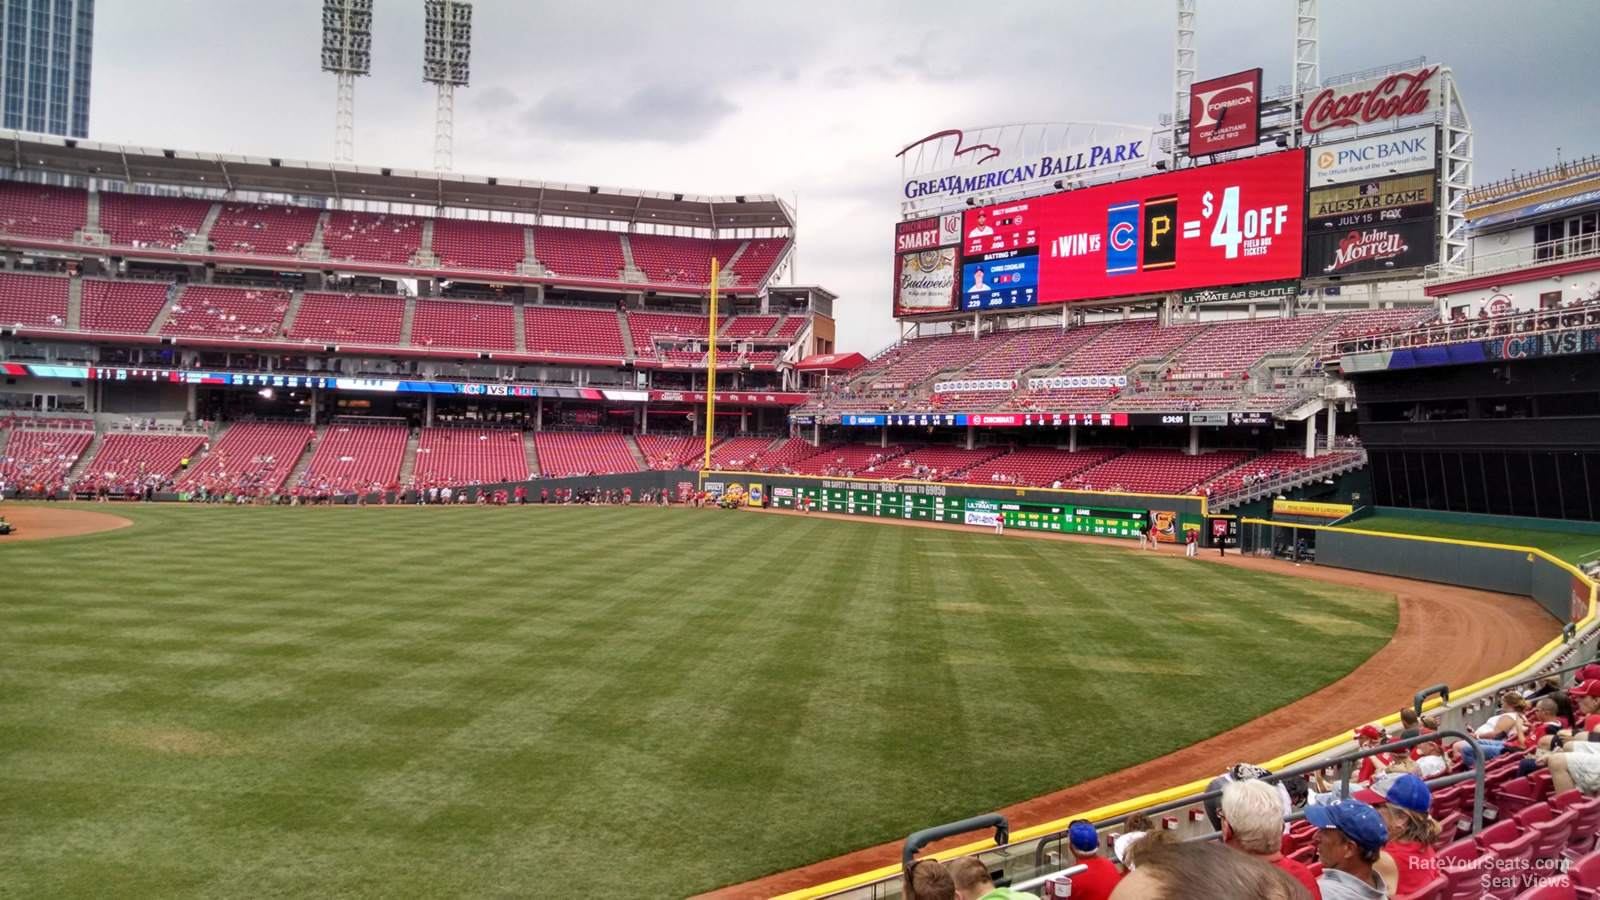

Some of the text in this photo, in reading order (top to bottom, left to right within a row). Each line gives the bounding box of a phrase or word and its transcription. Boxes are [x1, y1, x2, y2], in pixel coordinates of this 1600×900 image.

[1208, 97, 1251, 112] FORMICA
[1303, 66, 1439, 133] Coca-Cola
[1200, 124, 1246, 138] CINCNATIANS
[1337, 136, 1426, 165] PNC BANK
[904, 140, 1143, 198] GREAT AMERICAN BALL PARK
[1382, 158, 1410, 167] Cincinnati
[1411, 154, 1427, 162] Reds
[1385, 189, 1425, 206] GAME
[1244, 205, 1288, 239] OFF
[1338, 208, 1402, 226] JULY 15 FOX
[899, 218, 938, 234] CINCINNATI
[899, 230, 938, 250] SMART
[1052, 232, 1101, 257] A WIN VS
[1244, 237, 1272, 248] FIELD BOX
[1357, 229, 1388, 246] John
[969, 244, 982, 252] .272
[984, 251, 1009, 260] BATTING
[1244, 246, 1267, 256] TICKETS
[1324, 234, 1408, 272] Morrell
[1184, 292, 1229, 304] ULTIMATE
[1230, 291, 1246, 299] AIR
[1248, 286, 1296, 298] SHUTTLE
[1548, 333, 1576, 353] VS
[490, 386, 505, 394] VS
[850, 482, 868, 490] SERVICE
[904, 486, 918, 494] ISSUE
[926, 486, 946, 496] 69050
[1066, 514, 1072, 522] VS
